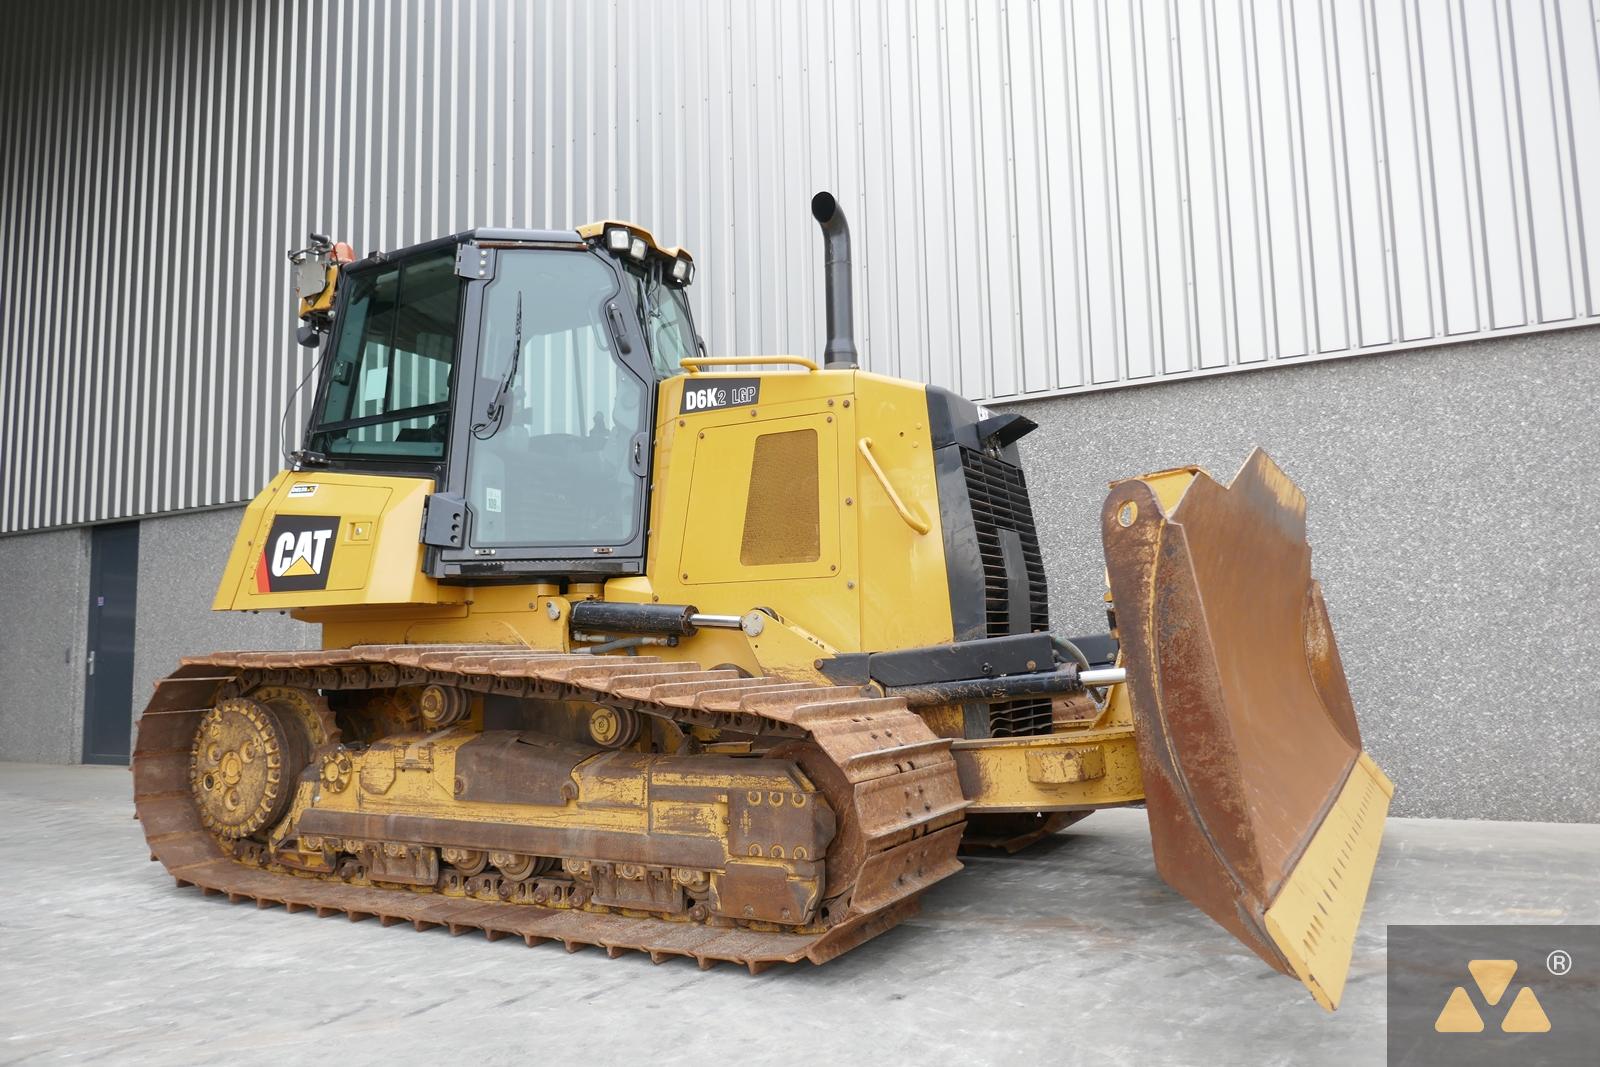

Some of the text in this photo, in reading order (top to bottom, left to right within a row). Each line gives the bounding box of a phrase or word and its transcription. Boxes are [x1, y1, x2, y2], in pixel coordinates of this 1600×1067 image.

[686, 387, 756, 410] D6K2 LGP
[271, 530, 333, 577] CAT
